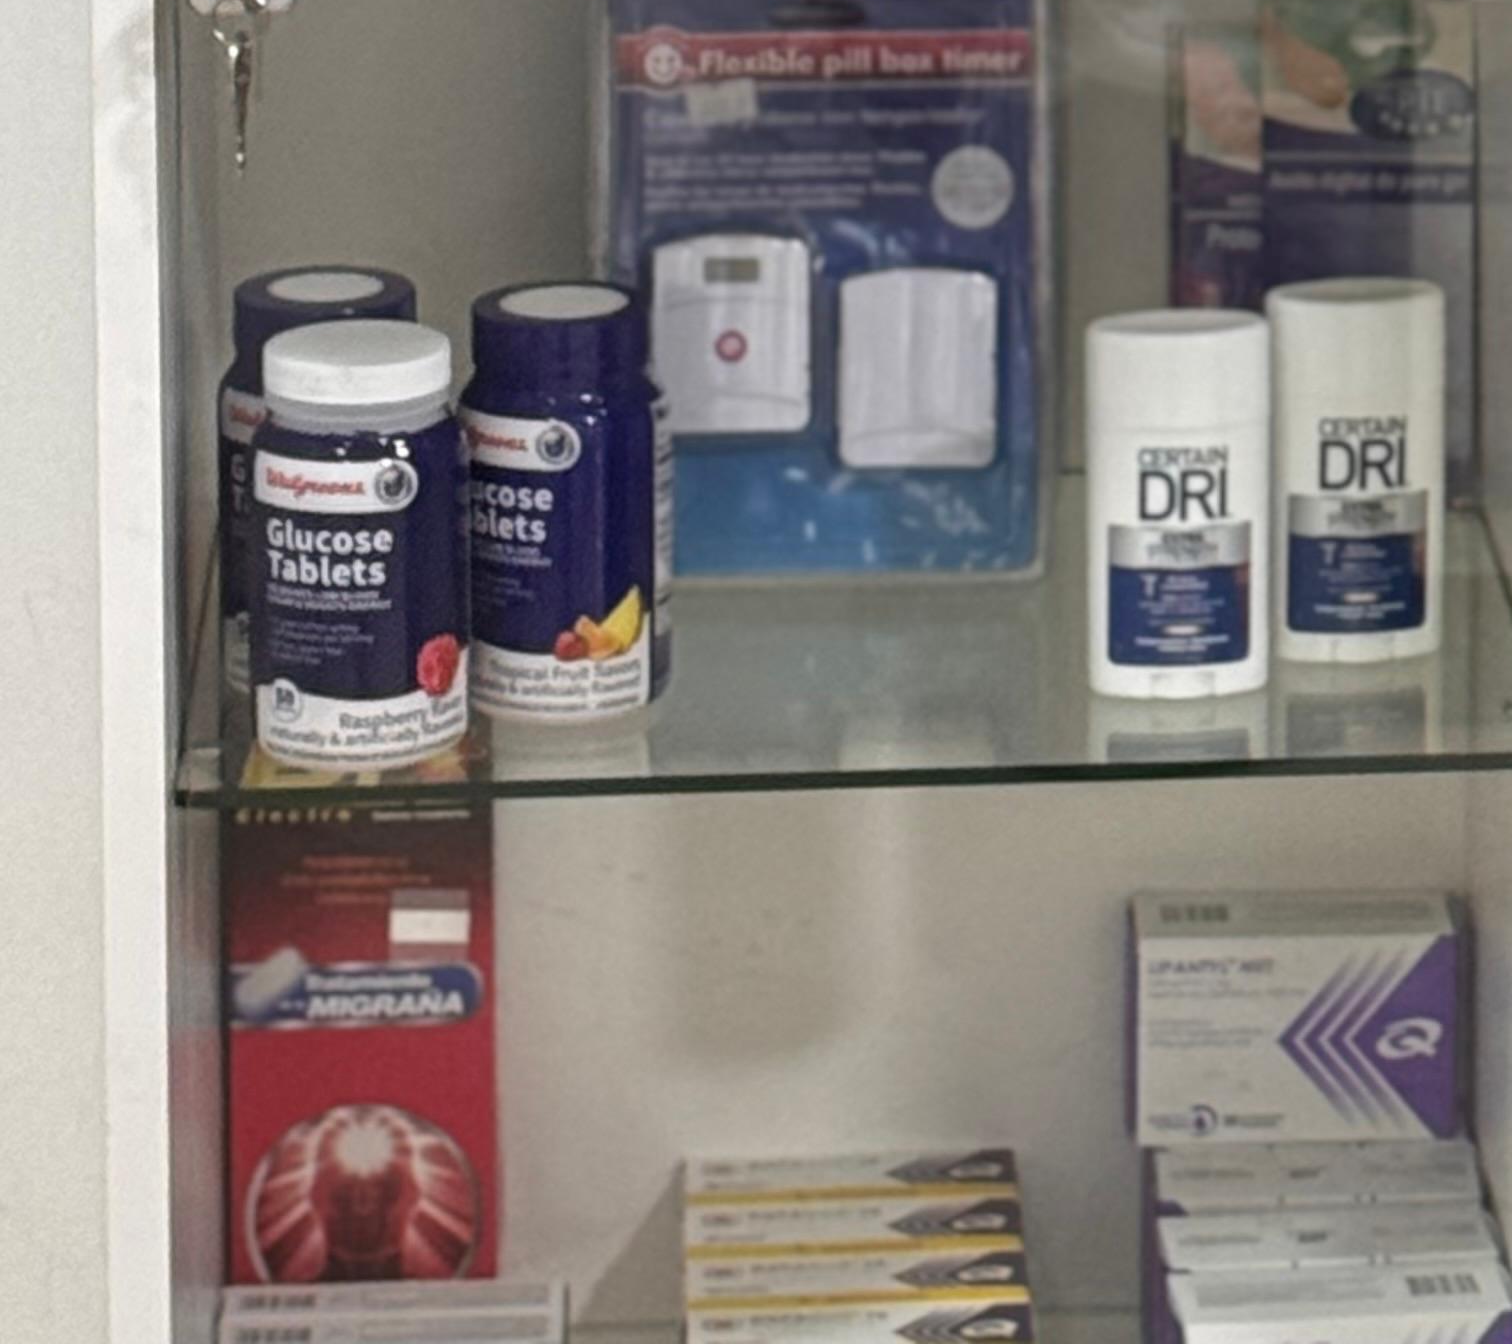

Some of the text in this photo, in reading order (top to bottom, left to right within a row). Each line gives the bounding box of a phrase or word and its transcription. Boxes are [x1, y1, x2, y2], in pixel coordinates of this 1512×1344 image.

[700, 45, 1023, 78] Flexible pill box timer
[1318, 416, 1408, 437] CERTAIN
[1138, 444, 1229, 466] CERTAIN
[1319, 437, 1406, 491] DRI
[266, 465, 367, 498] Walgreens
[471, 480, 554, 512] ucose
[1139, 468, 1229, 522] DRI
[266, 517, 393, 556] Glucose
[474, 504, 546, 543] blets
[266, 548, 386, 588] Tablets
[339, 708, 427, 737] Raspberry
[306, 988, 465, 1020] MIGRAÑA
